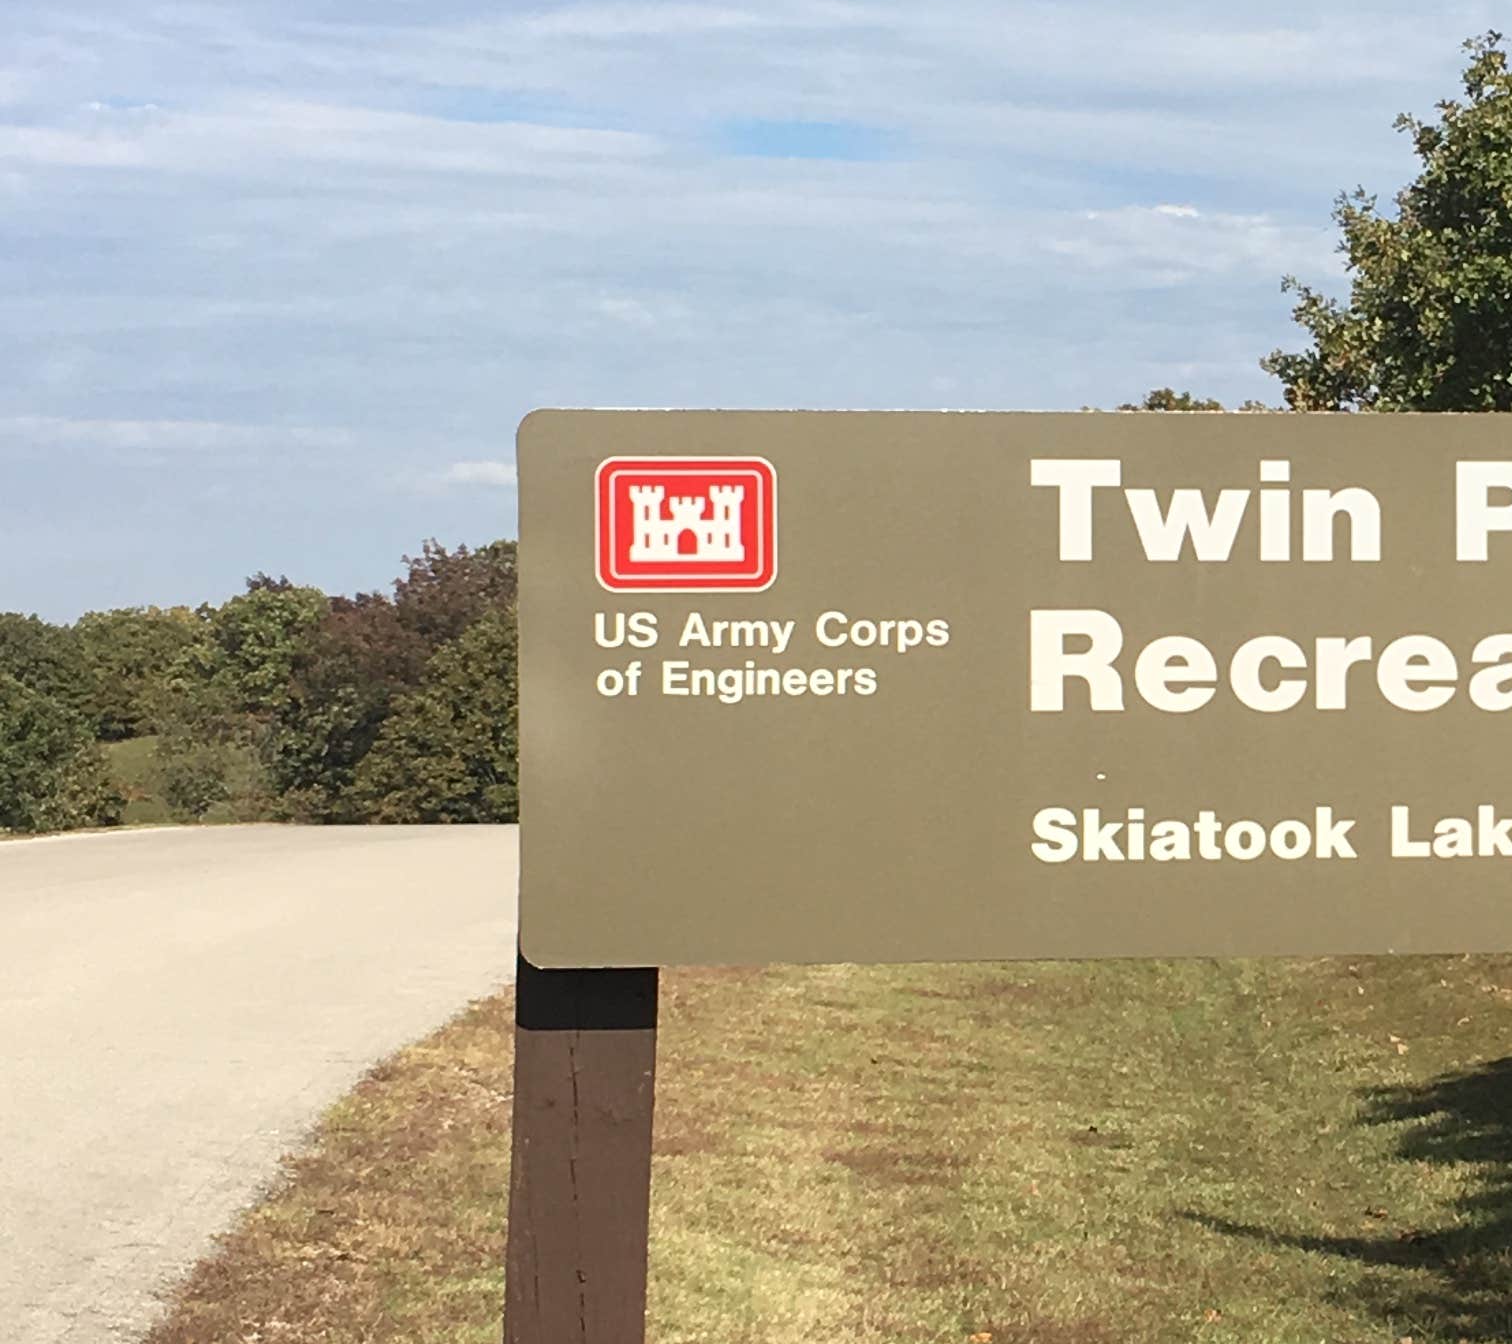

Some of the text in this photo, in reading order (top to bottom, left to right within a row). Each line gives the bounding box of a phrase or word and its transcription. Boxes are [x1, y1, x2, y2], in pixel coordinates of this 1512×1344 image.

[1030, 459, 1381, 562] Twin
[595, 611, 950, 654] US Army Corps
[597, 660, 877, 704] of Engineers
[1031, 806, 1358, 863] Skiatook
